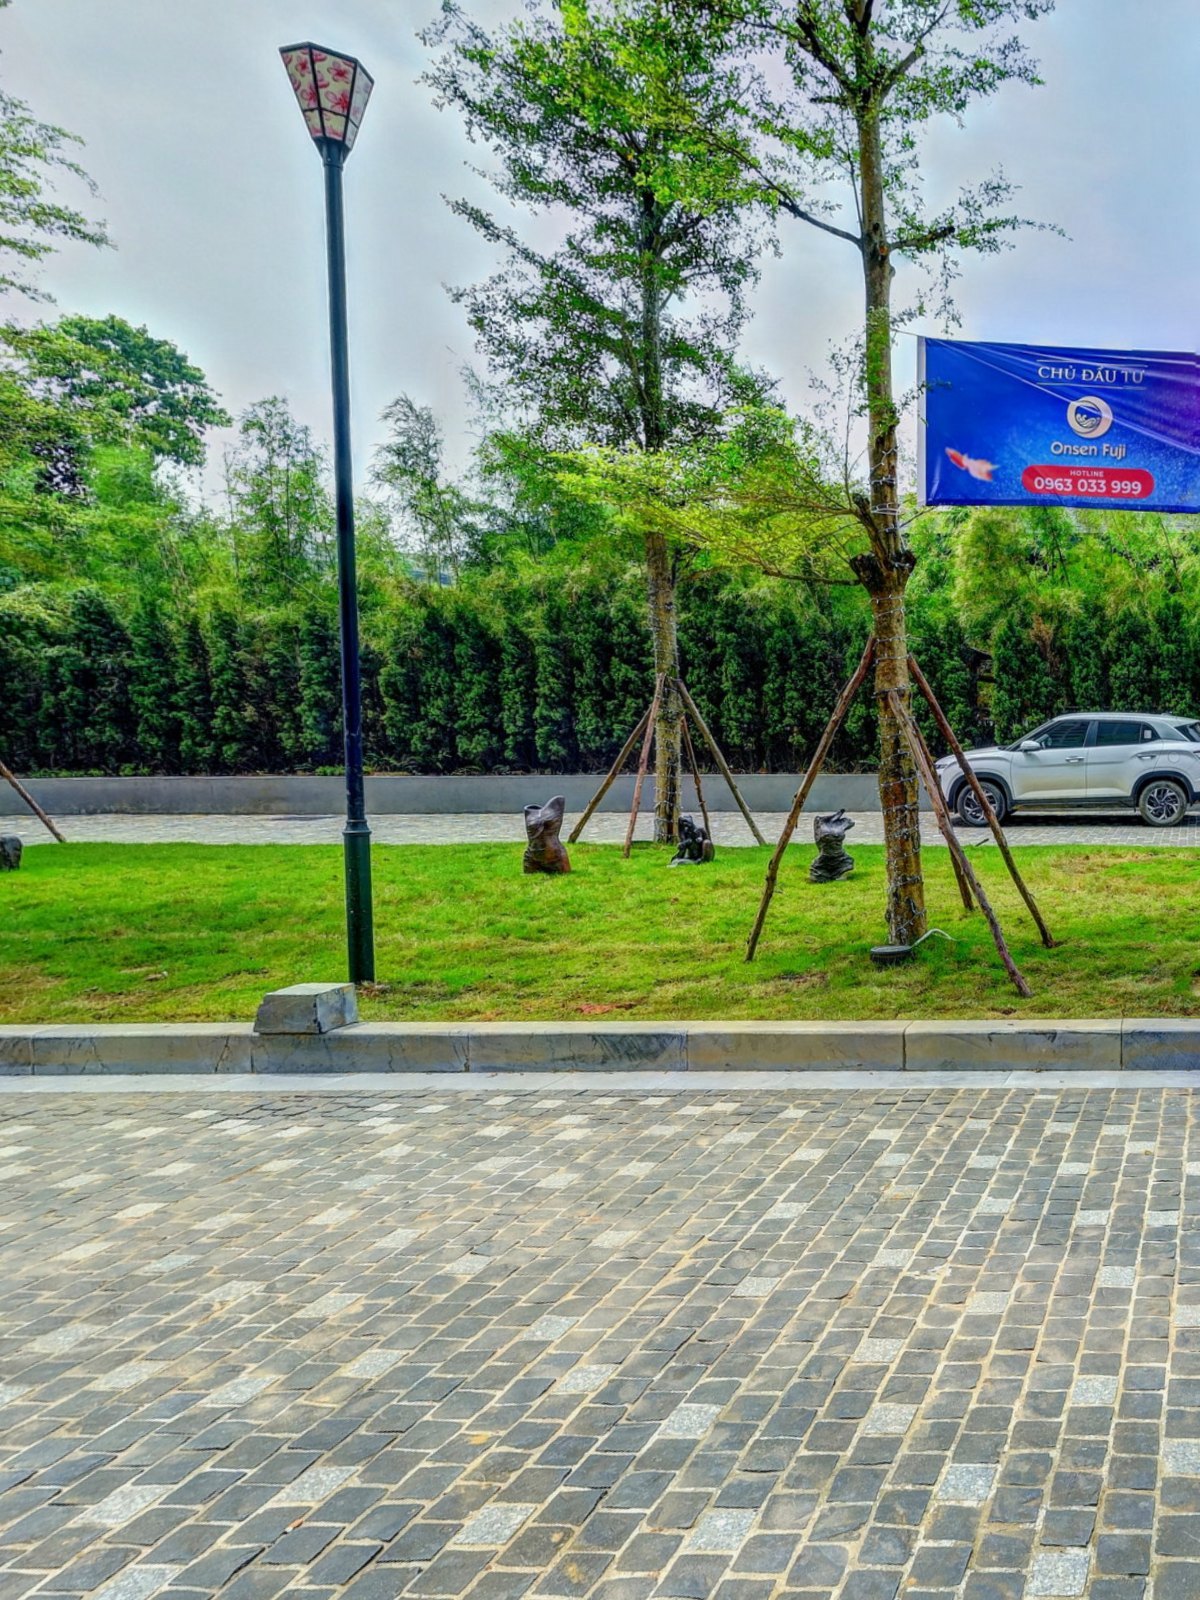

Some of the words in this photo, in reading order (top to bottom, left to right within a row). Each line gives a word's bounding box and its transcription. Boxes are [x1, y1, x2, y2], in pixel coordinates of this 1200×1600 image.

[1038, 365, 1076, 380] CHỦ
[1082, 366, 1117, 383] ĐẦU
[1121, 369, 1145, 384] TƯ
[1050, 441, 1097, 456] Onsen
[1102, 443, 1126, 460] Fuji
[1034, 477, 1073, 492] 0963
[1077, 479, 1106, 493] 033
[1111, 480, 1142, 495] 999
